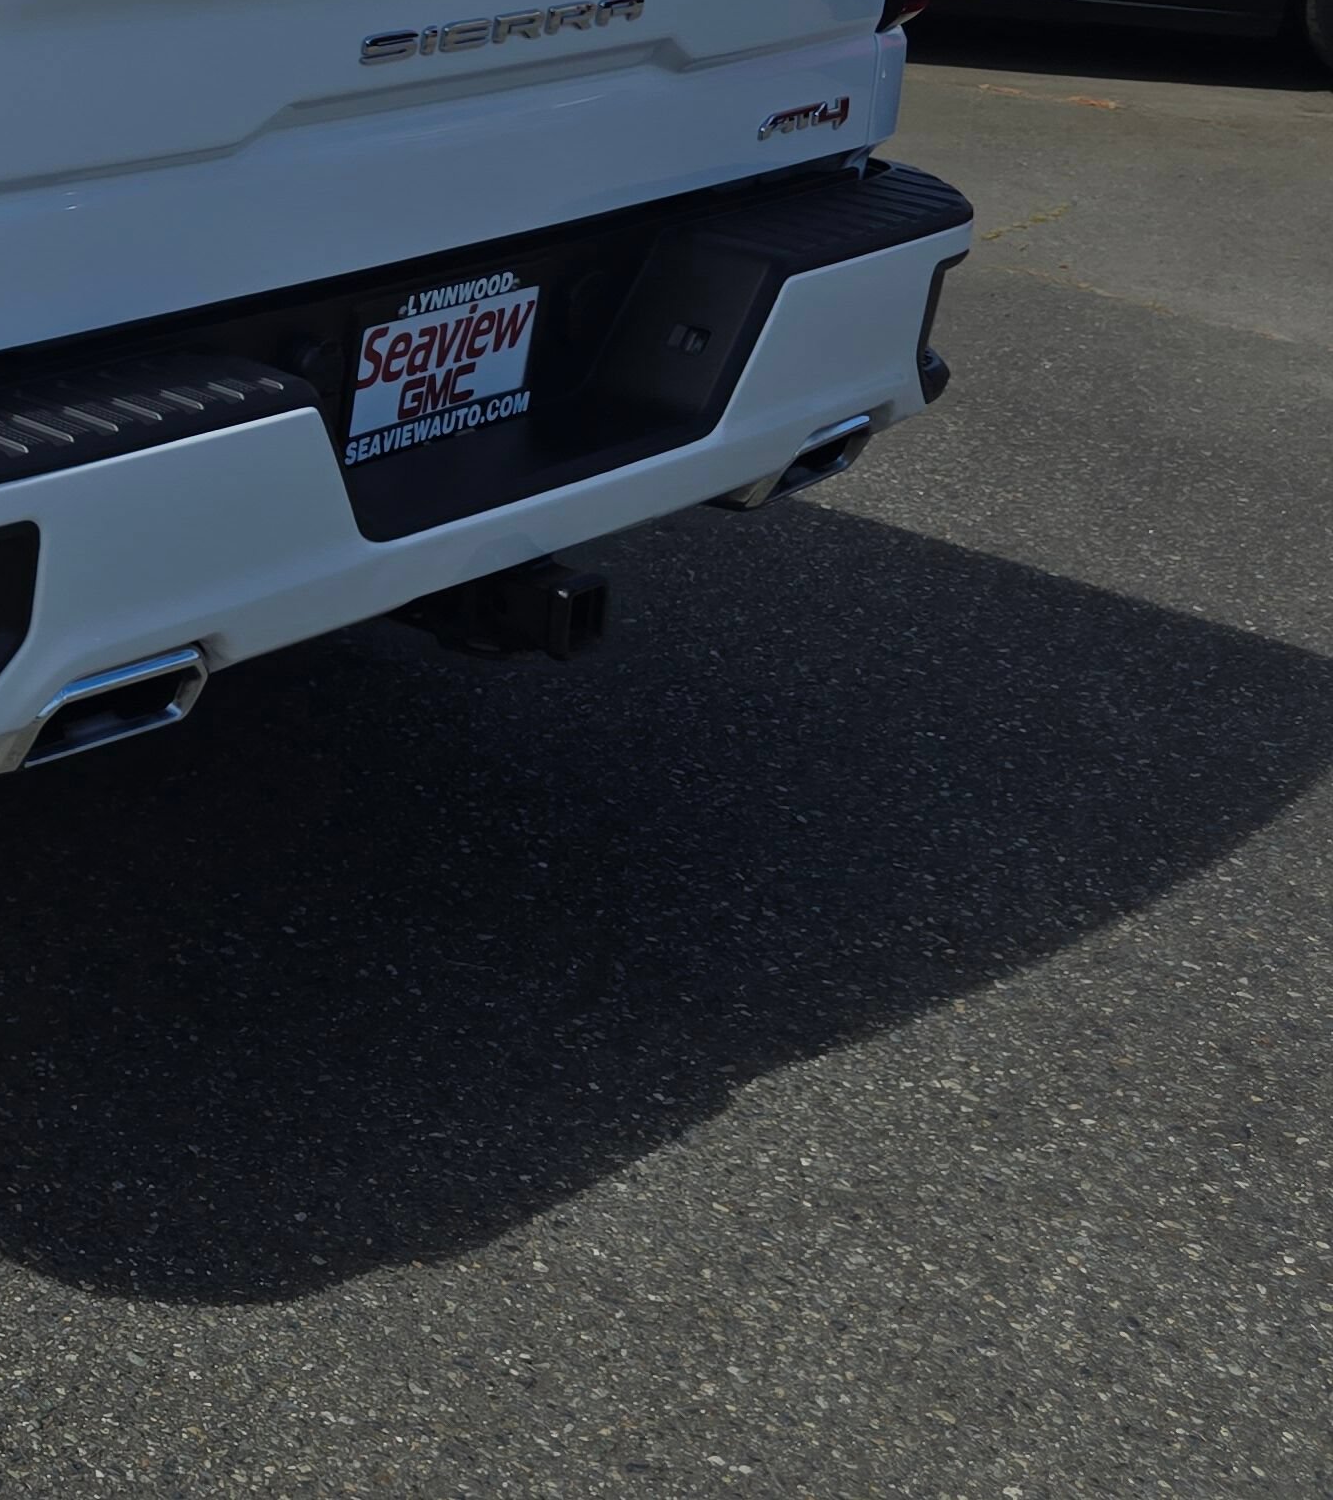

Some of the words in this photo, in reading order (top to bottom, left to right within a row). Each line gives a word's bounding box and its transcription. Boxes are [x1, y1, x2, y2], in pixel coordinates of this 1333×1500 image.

[757, 96, 850, 142] AT4
[407, 272, 515, 317] LYNNWOOD
[356, 300, 536, 389] Seaview
[398, 362, 476, 421] GMC
[344, 391, 531, 466] SEAVIEWAUTO.COM
